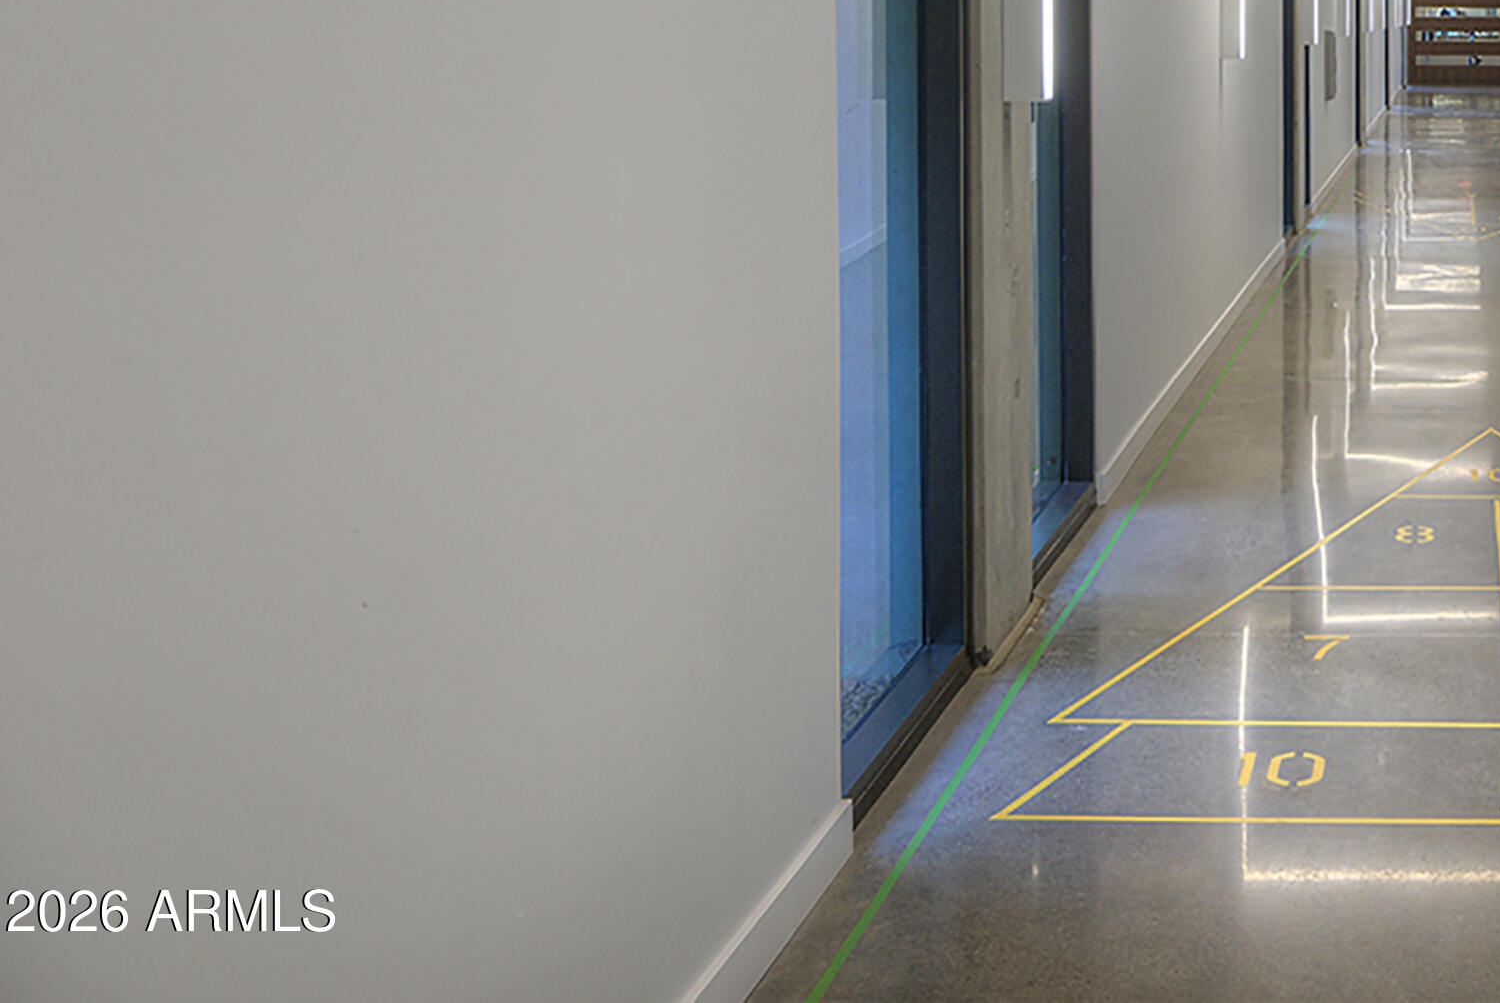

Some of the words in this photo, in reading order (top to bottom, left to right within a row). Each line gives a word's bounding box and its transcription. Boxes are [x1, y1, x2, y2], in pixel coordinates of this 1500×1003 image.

[1395, 525, 1435, 544] 8
[1304, 634, 1350, 660] 7
[1237, 751, 1326, 787] 10
